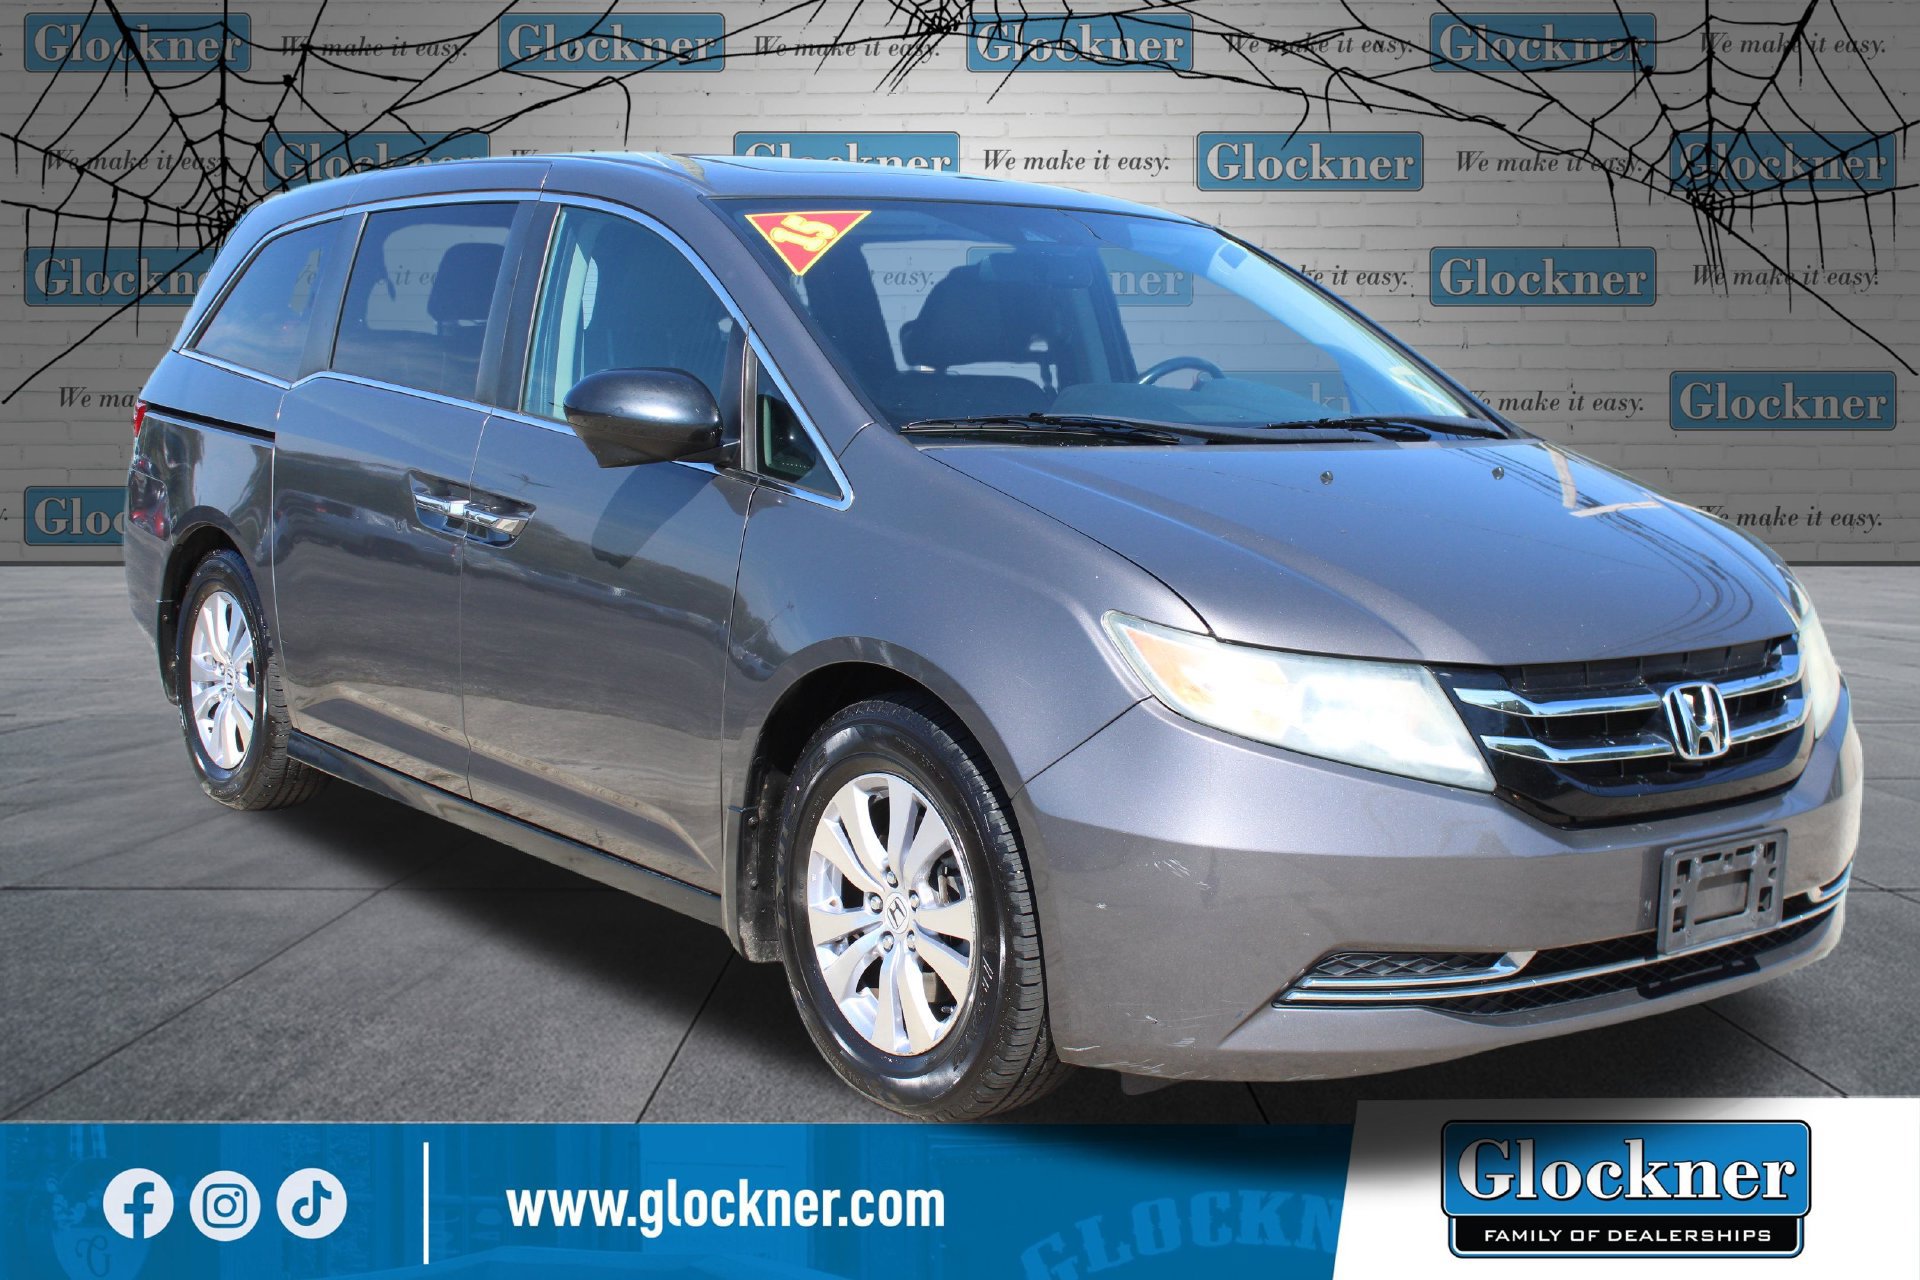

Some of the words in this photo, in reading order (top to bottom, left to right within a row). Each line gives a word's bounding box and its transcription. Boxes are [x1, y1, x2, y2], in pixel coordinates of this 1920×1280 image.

[33, 23, 242, 62] Glockner
[320, 35, 383, 56] make
[391, 35, 407, 56] it
[414, 42, 467, 63] easy.
[506, 23, 715, 62] Glockner
[754, 35, 787, 56] We
[794, 35, 857, 56] make
[865, 35, 881, 56] it
[888, 42, 941, 63] easy.
[975, 23, 1184, 62] Glockner
[1226, 32, 1259, 53] We
[1337, 32, 1353, 53] it
[1360, 39, 1413, 60] easy.
[1438, 23, 1647, 62] Glockner
[1700, 32, 1733, 53] We
[1811, 32, 1827, 53] it
[1834, 39, 1887, 60] easy.
[46, 149, 79, 170] We
[86, 149, 149, 170] make
[157, 149, 173, 170] it
[273, 142, 480, 181] Glok
[983, 149, 1016, 170] We
[1023, 149, 1086, 170] make
[1094, 149, 1110, 170] it
[1117, 156, 1170, 177] easy.
[1205, 142, 1414, 181] Glockner
[1456, 151, 1489, 172] We
[1496, 151, 1559, 172] make
[1678, 142, 1887, 181] Glockner
[33, 257, 206, 297] Glockn
[883, 271, 935, 292] easy.
[1331, 264, 1348, 285] it
[1355, 271, 1408, 292] easy.
[1438, 257, 1647, 296] Glockner
[1692, 264, 1725, 285] We
[1732, 264, 1795, 285] make
[1803, 264, 1819, 285] it
[1826, 271, 1879, 292] easy.
[58, 386, 91, 408] We
[99, 386, 142, 408] ma
[1498, 390, 1561, 411] make
[1569, 390, 1585, 411] it
[1592, 397, 1645, 418] easy.
[1678, 381, 1887, 420] Glockner
[1736, 505, 1799, 526] make
[1807, 505, 1823, 526] it
[1830, 512, 1883, 533] easy.
